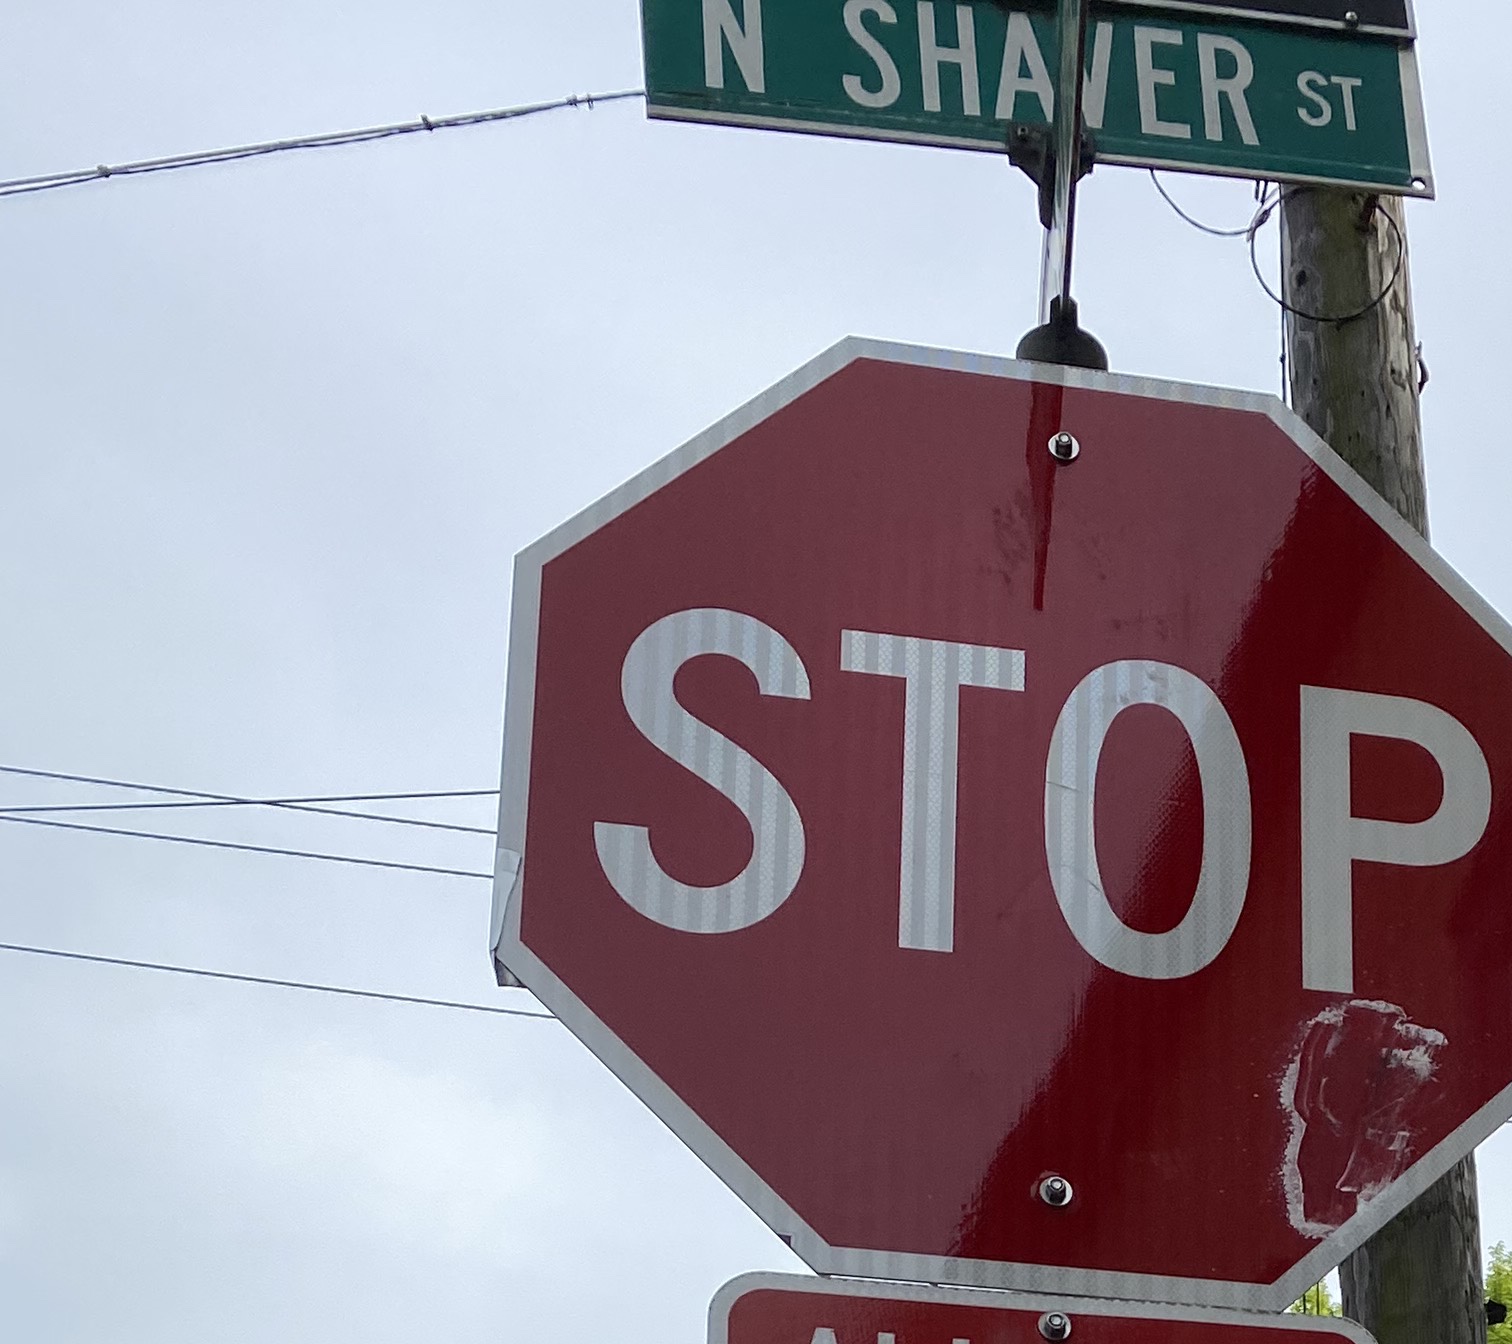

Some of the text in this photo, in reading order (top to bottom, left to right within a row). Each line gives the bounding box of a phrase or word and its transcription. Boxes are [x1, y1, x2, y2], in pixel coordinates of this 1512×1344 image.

[703, 0, 1362, 146] N SHAVER ST
[592, 606, 1494, 995] STOP
